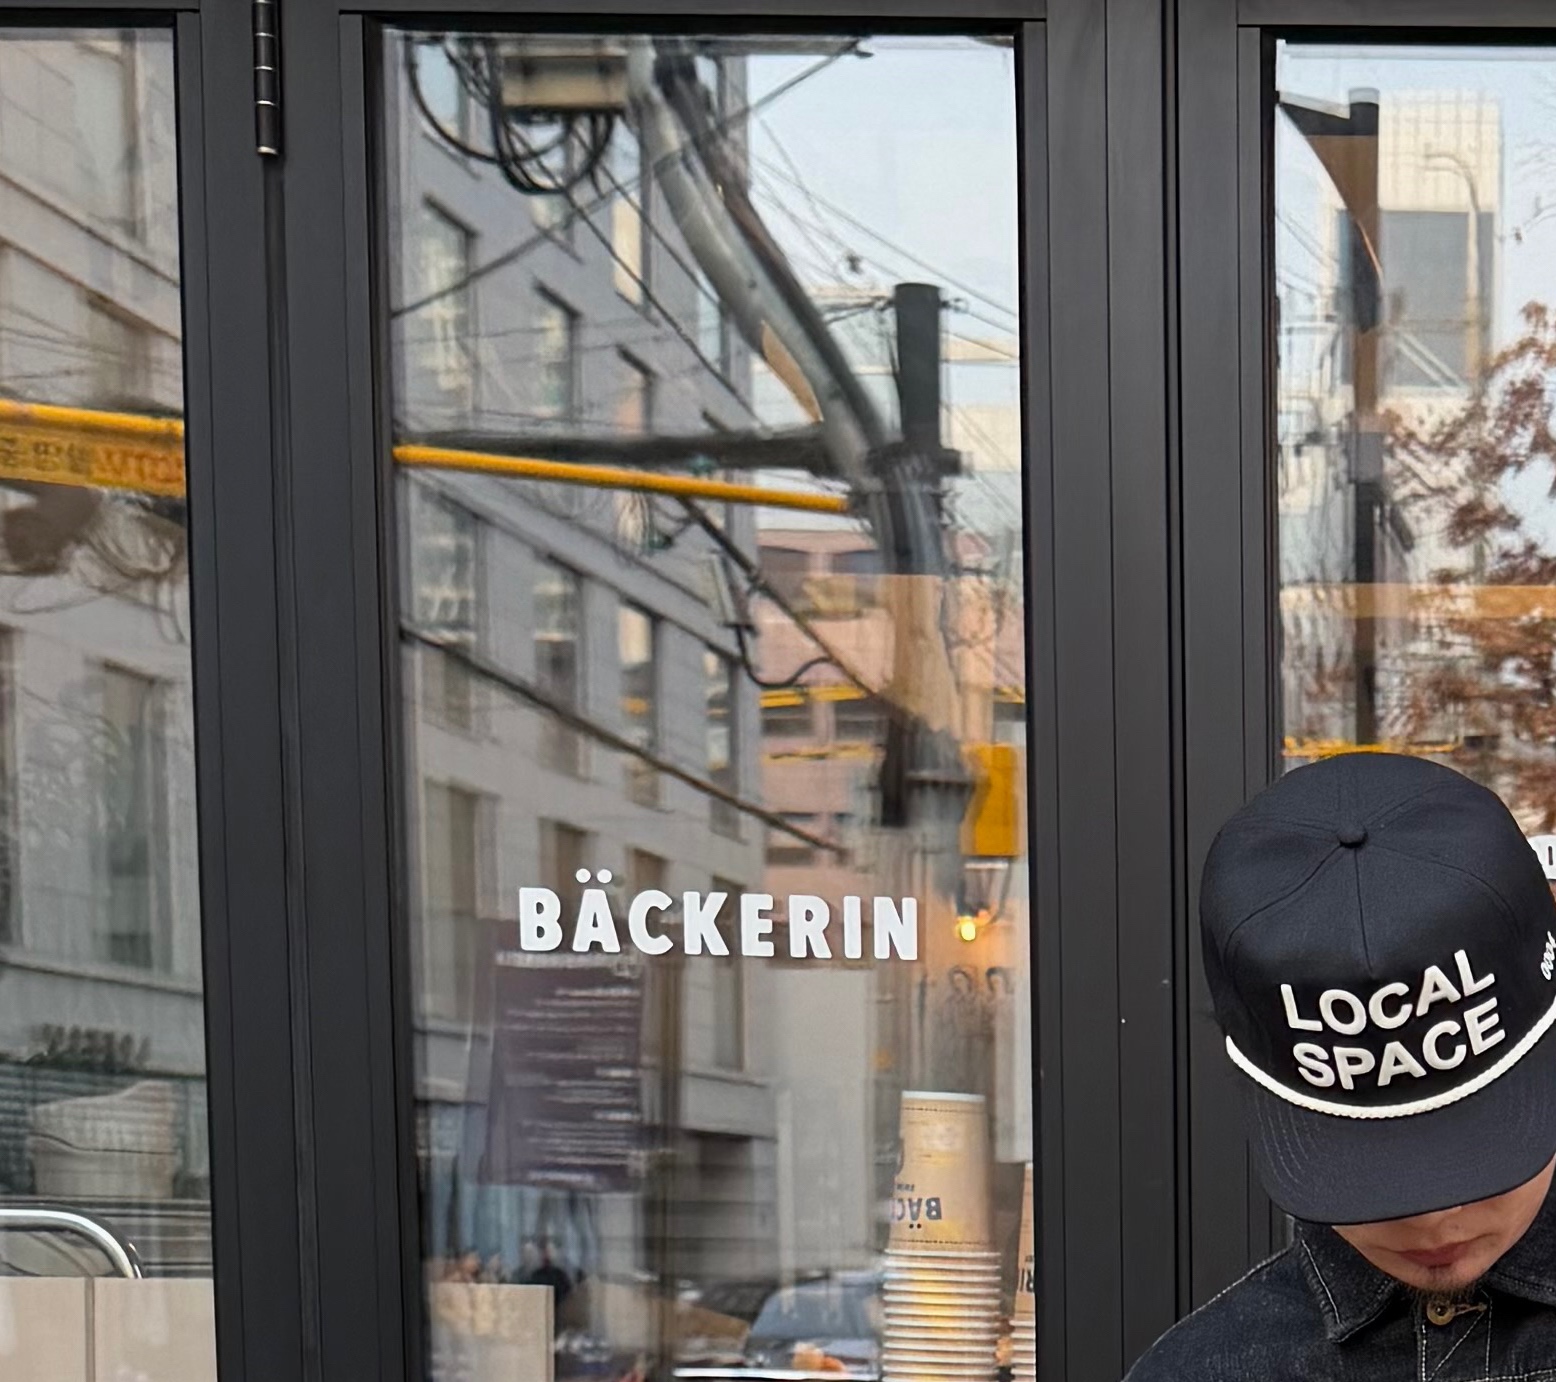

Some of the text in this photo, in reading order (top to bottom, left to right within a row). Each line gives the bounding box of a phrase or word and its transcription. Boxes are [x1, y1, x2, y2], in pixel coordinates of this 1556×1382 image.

[518, 868, 918, 960] BÄCKERIN
[1280, 949, 1495, 1036] LOCAL
[1293, 997, 1505, 1090] SPACE
